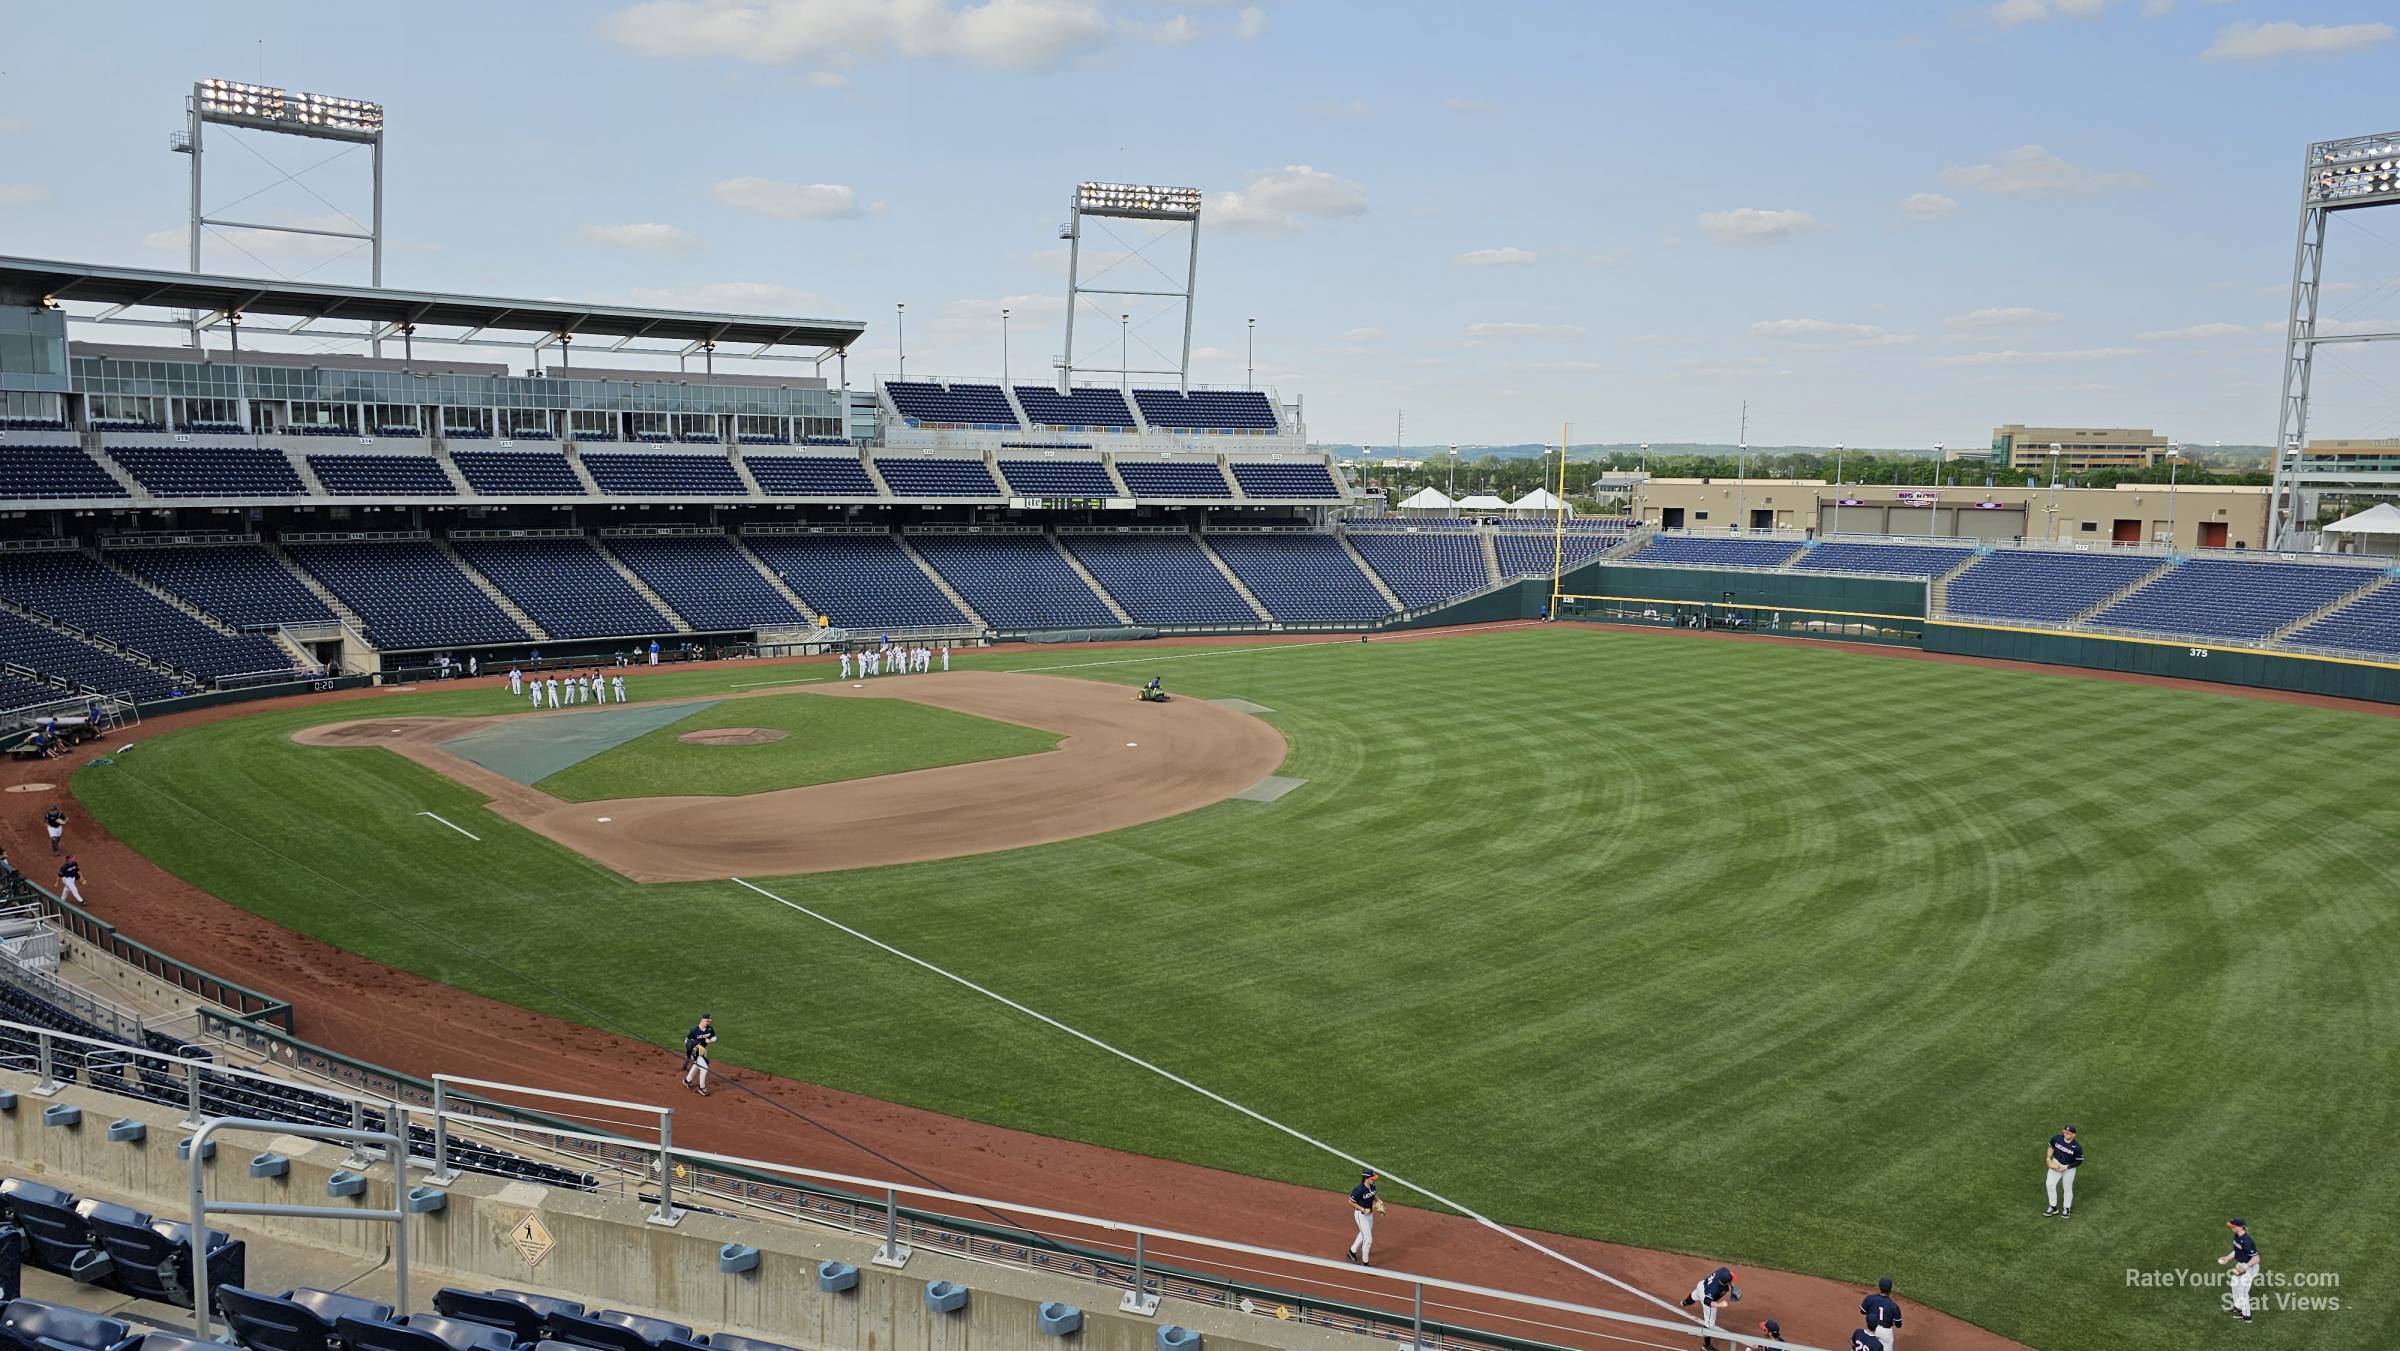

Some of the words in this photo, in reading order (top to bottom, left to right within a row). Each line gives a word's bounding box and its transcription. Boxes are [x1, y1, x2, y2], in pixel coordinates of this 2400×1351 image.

[2190, 648, 2208, 658] 375
[315, 680, 334, 691] 0:20
[1879, 1306, 1884, 1320] 1
